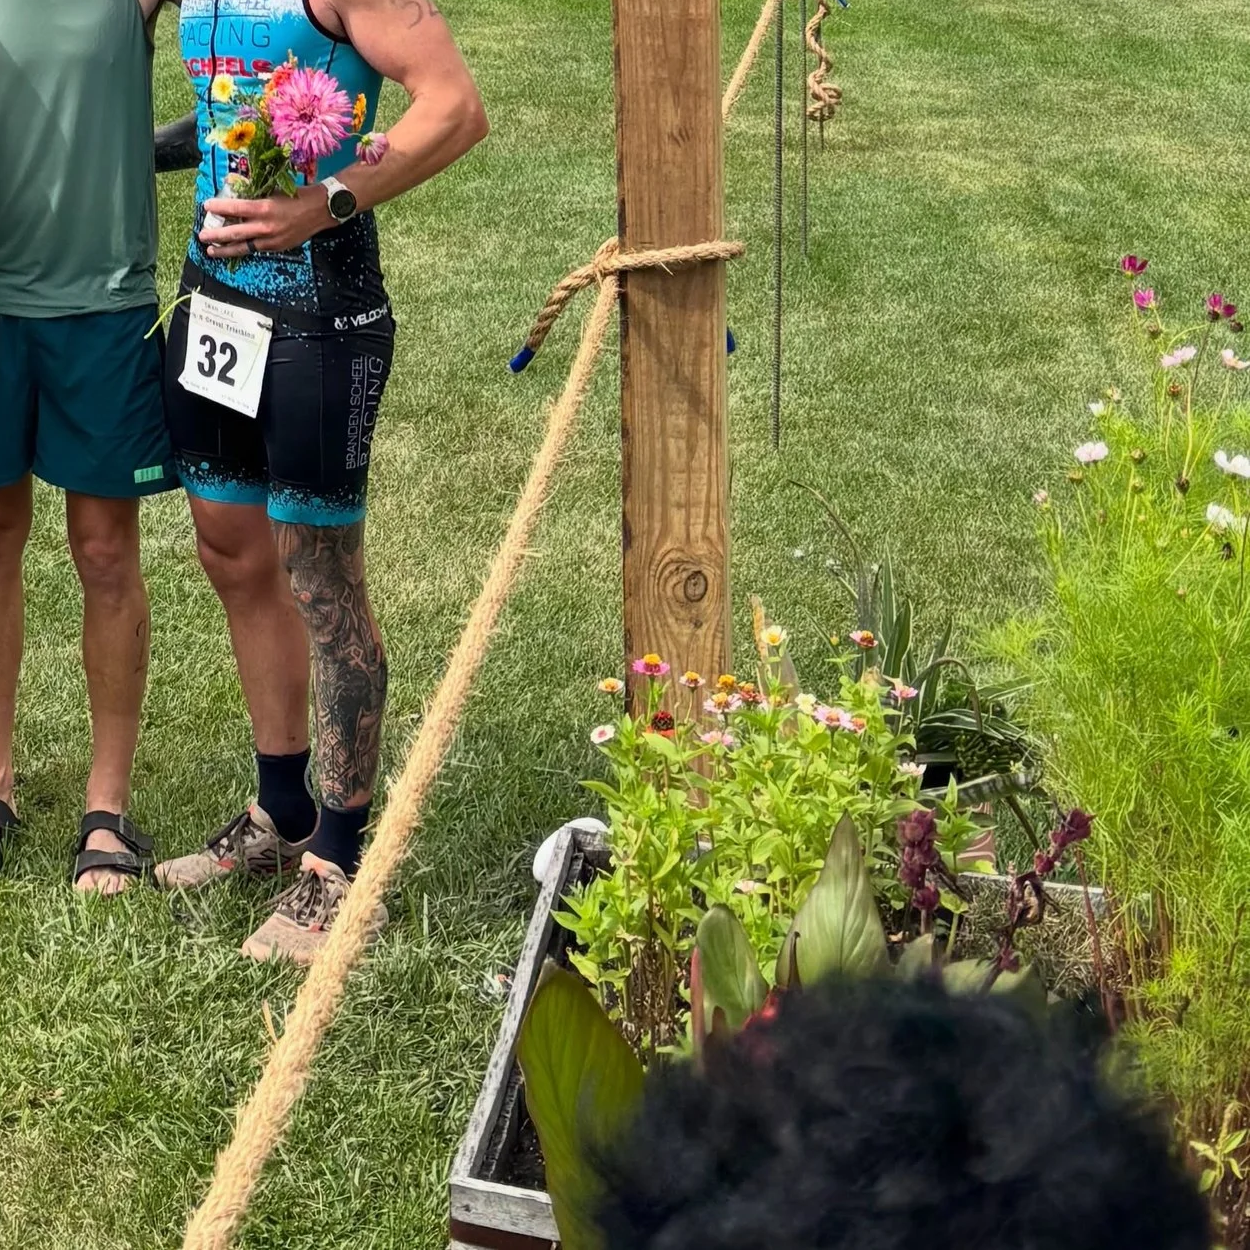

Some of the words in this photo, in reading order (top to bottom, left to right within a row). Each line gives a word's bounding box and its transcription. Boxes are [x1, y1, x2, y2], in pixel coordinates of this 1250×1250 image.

[197, 334, 238, 387] 32
[350, 355, 363, 406] SCHEEL
[346, 408, 360, 470] BRANDEN
[359, 356, 384, 466] RACING
